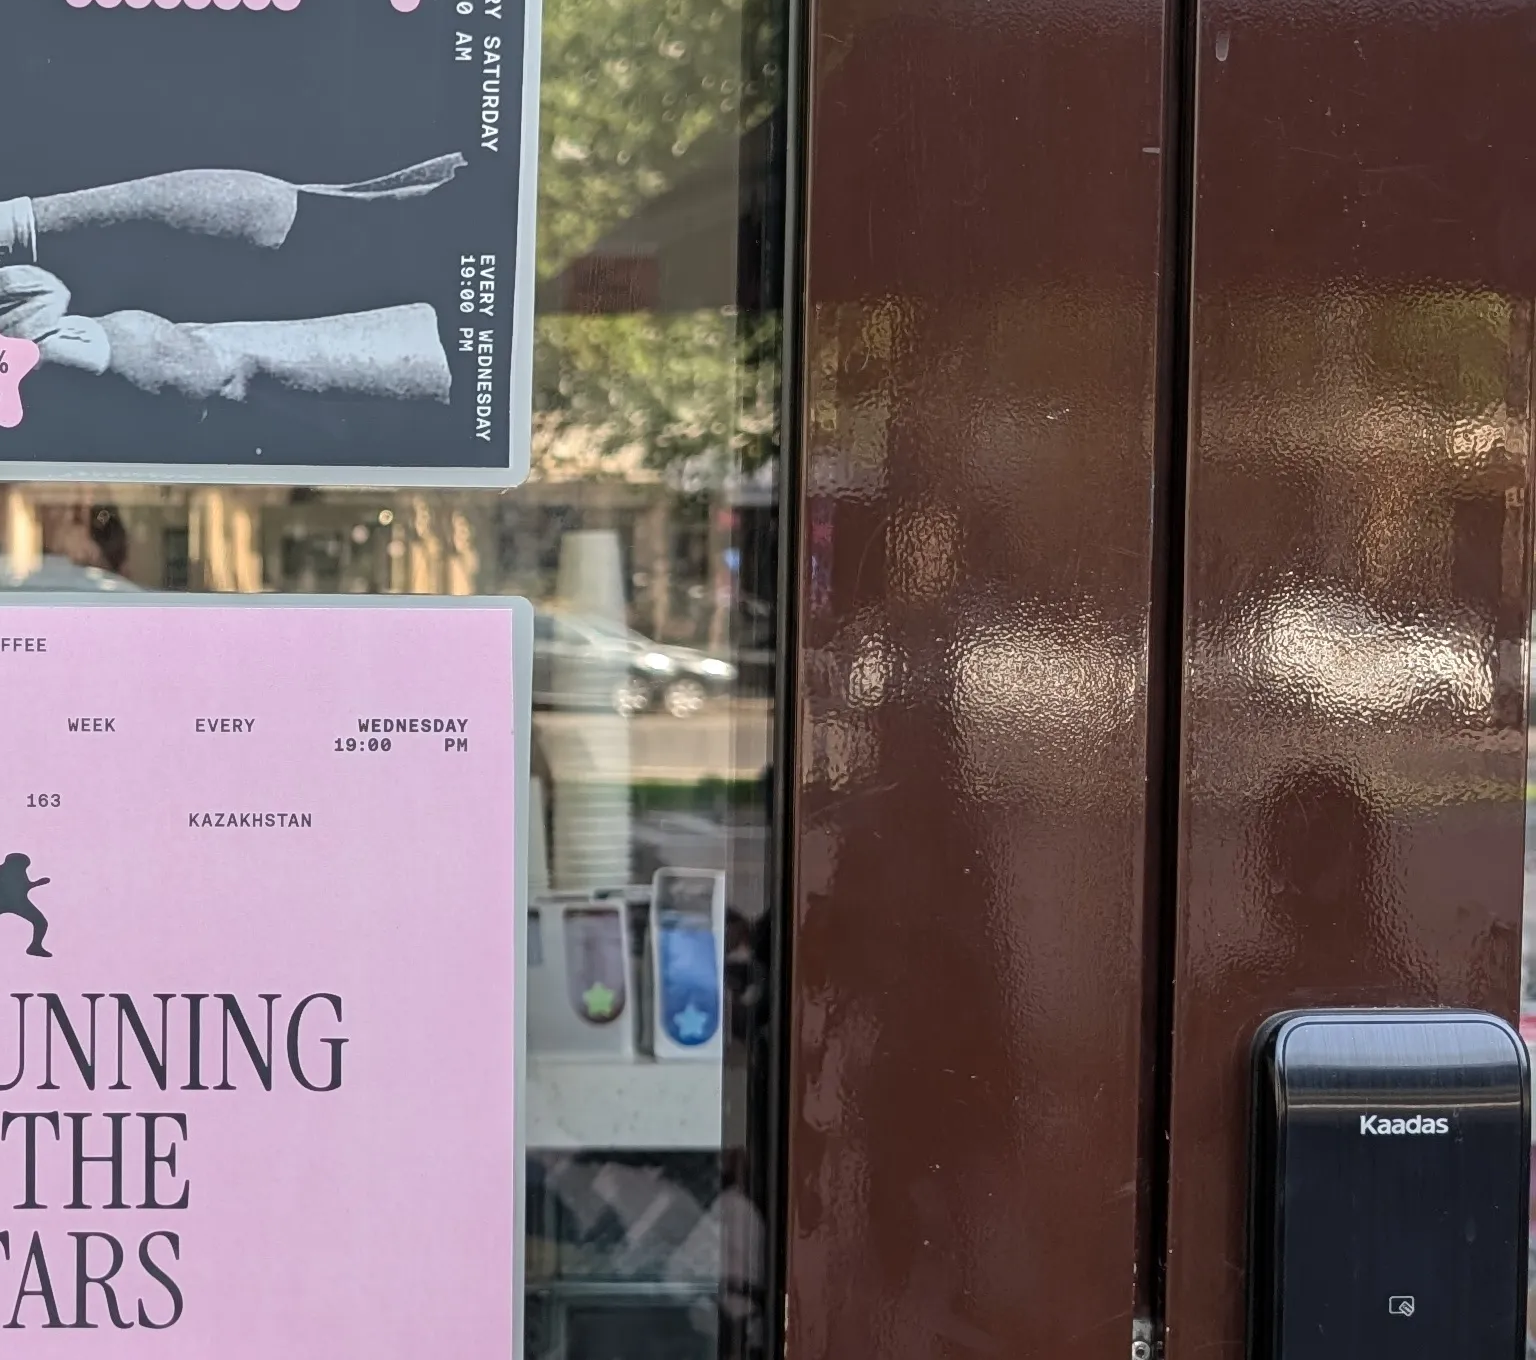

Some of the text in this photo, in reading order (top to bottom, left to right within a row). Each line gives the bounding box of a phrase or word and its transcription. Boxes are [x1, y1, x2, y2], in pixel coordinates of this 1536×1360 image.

[454, 31, 473, 61] AM
[480, 35, 501, 153] SATURDAY
[458, 255, 476, 352] 19:00 PM
[475, 254, 495, 442] EVERY WEDNESDAY
[67, 717, 116, 733] WEEK
[195, 718, 256, 733] EVERY
[357, 718, 469, 733] WEDNESDAY
[334, 738, 392, 753] 19:00
[444, 738, 468, 753] PM
[26, 794, 61, 808] 163
[189, 813, 312, 828] KAZAKHSTAN
[1360, 1114, 1450, 1136] Kaadas
[1, 1110, 191, 1211] THE
